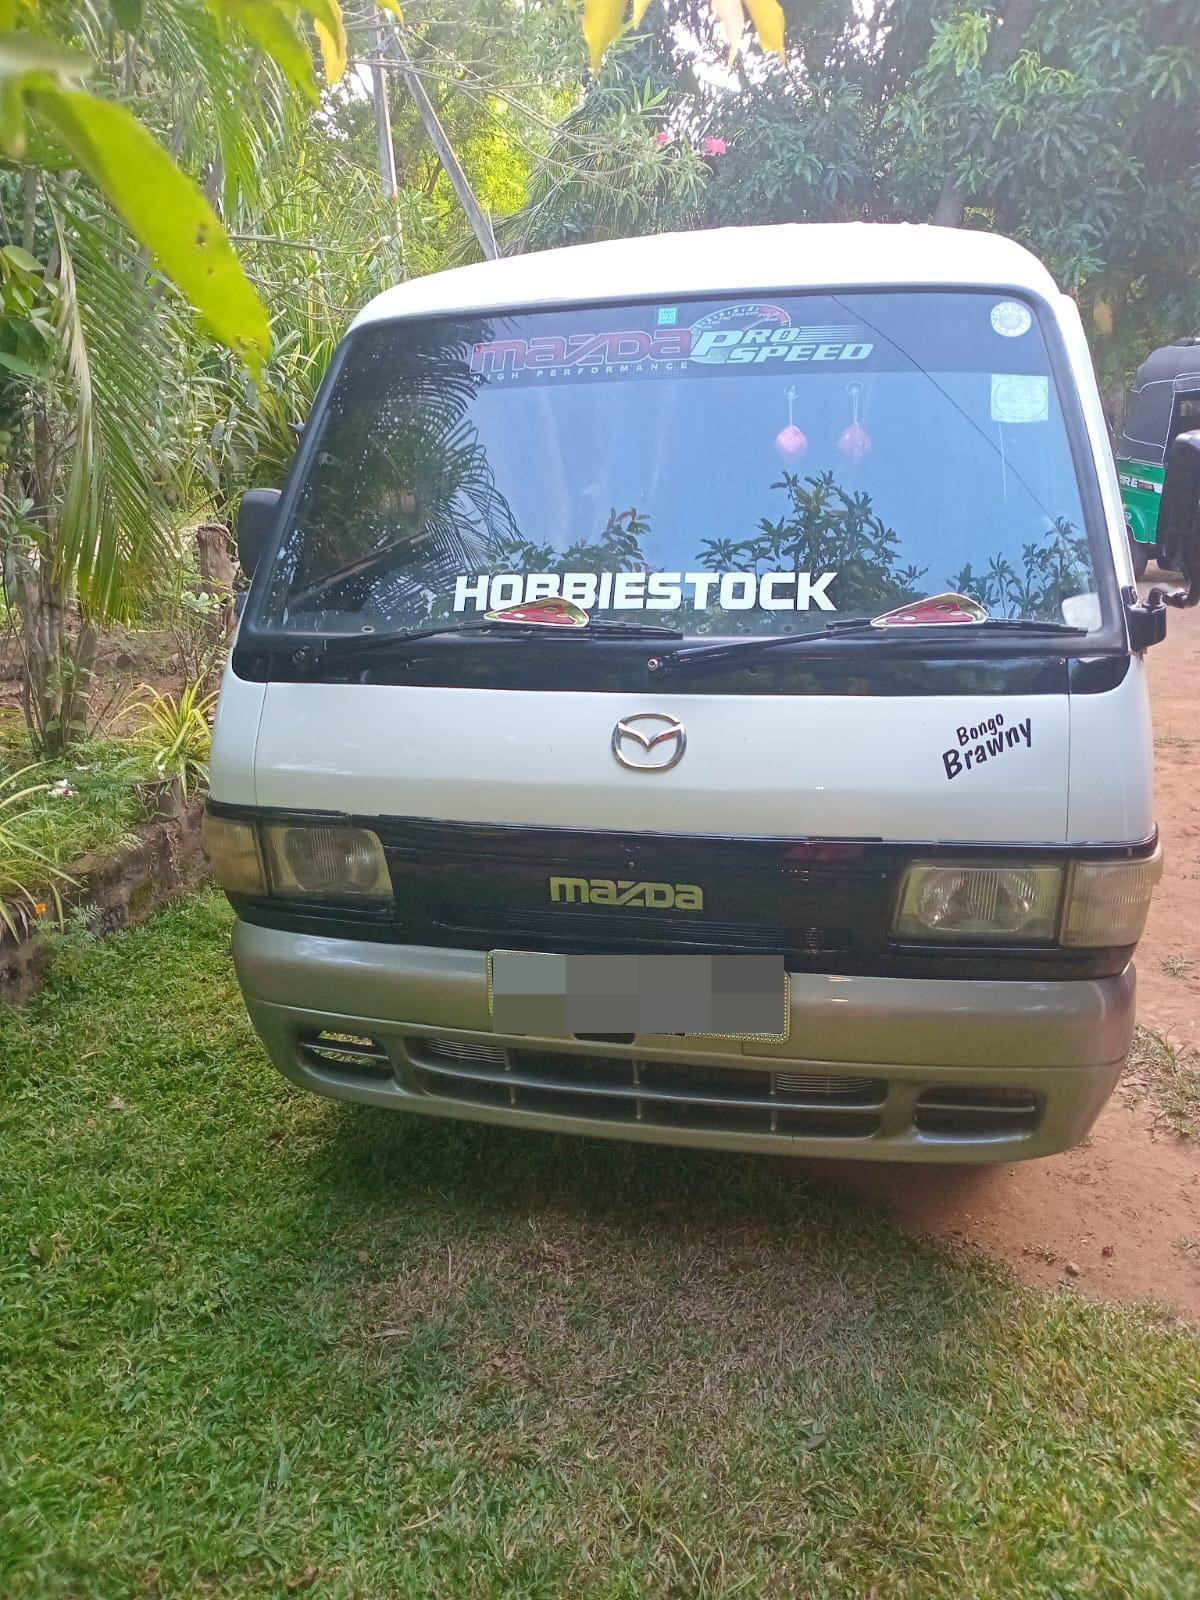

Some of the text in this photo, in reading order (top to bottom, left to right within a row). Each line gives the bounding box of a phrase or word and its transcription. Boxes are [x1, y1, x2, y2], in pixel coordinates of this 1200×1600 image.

[689, 327, 801, 357] PRO
[726, 343, 875, 364] SPEED
[472, 360, 688, 382] HIGH PERFORMANCE
[453, 571, 838, 613] HOBBIESTOCK
[956, 713, 1004, 747] Bongo
[942, 717, 1032, 780] Brawny
